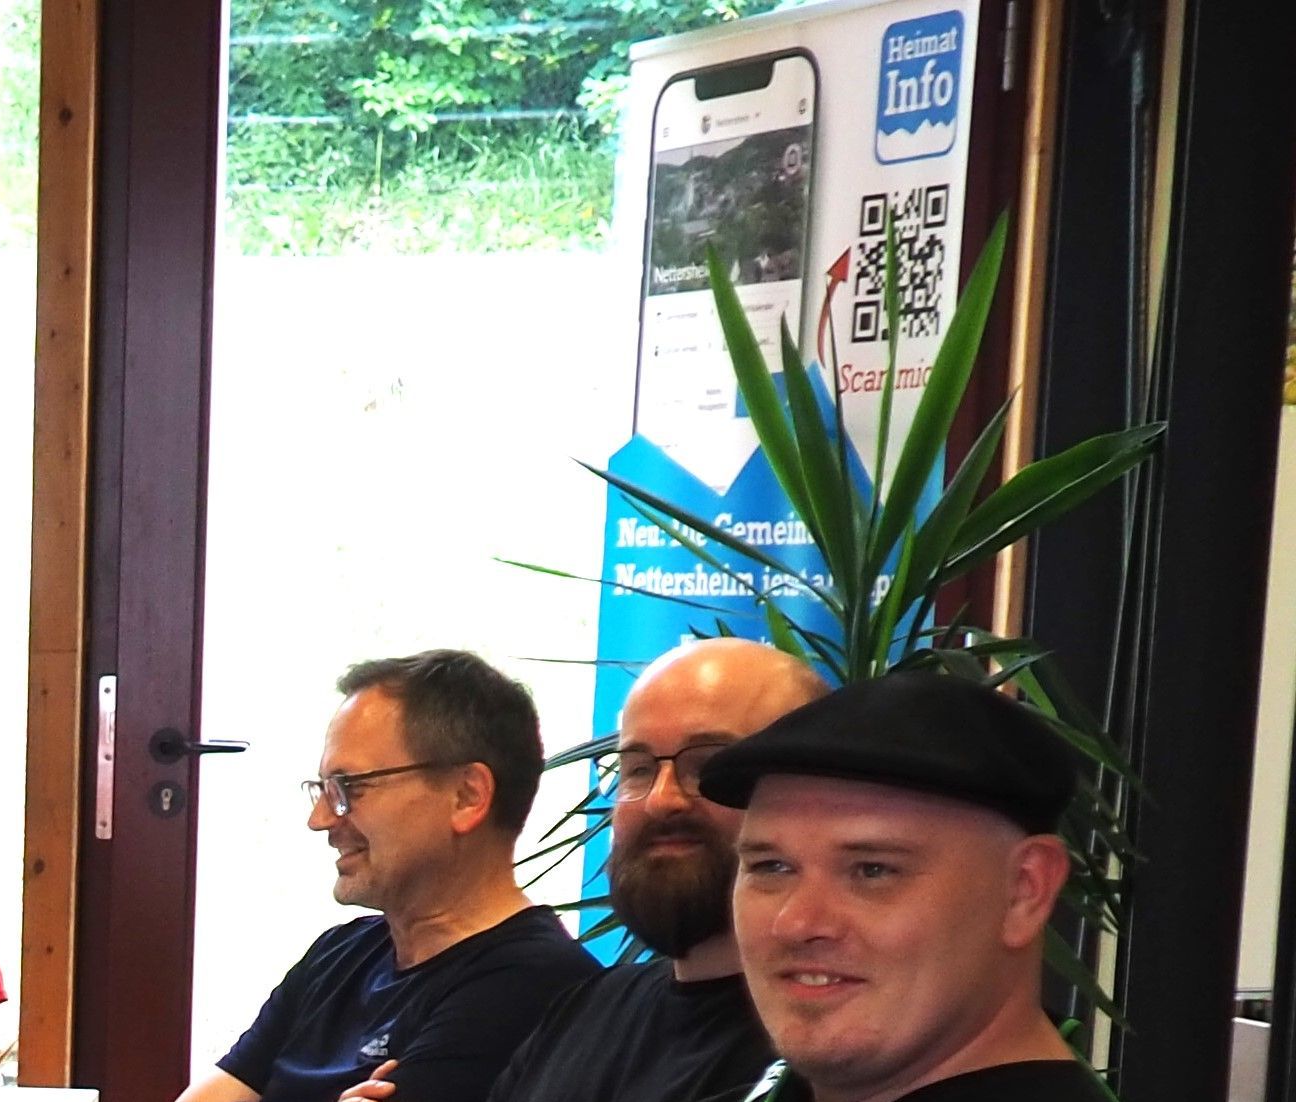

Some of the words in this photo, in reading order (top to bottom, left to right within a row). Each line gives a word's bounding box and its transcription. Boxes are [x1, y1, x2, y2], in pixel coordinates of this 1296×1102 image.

[887, 27, 957, 63] Heimat
[884, 58, 954, 116] Info
[613, 562, 754, 597] Nettersheim
